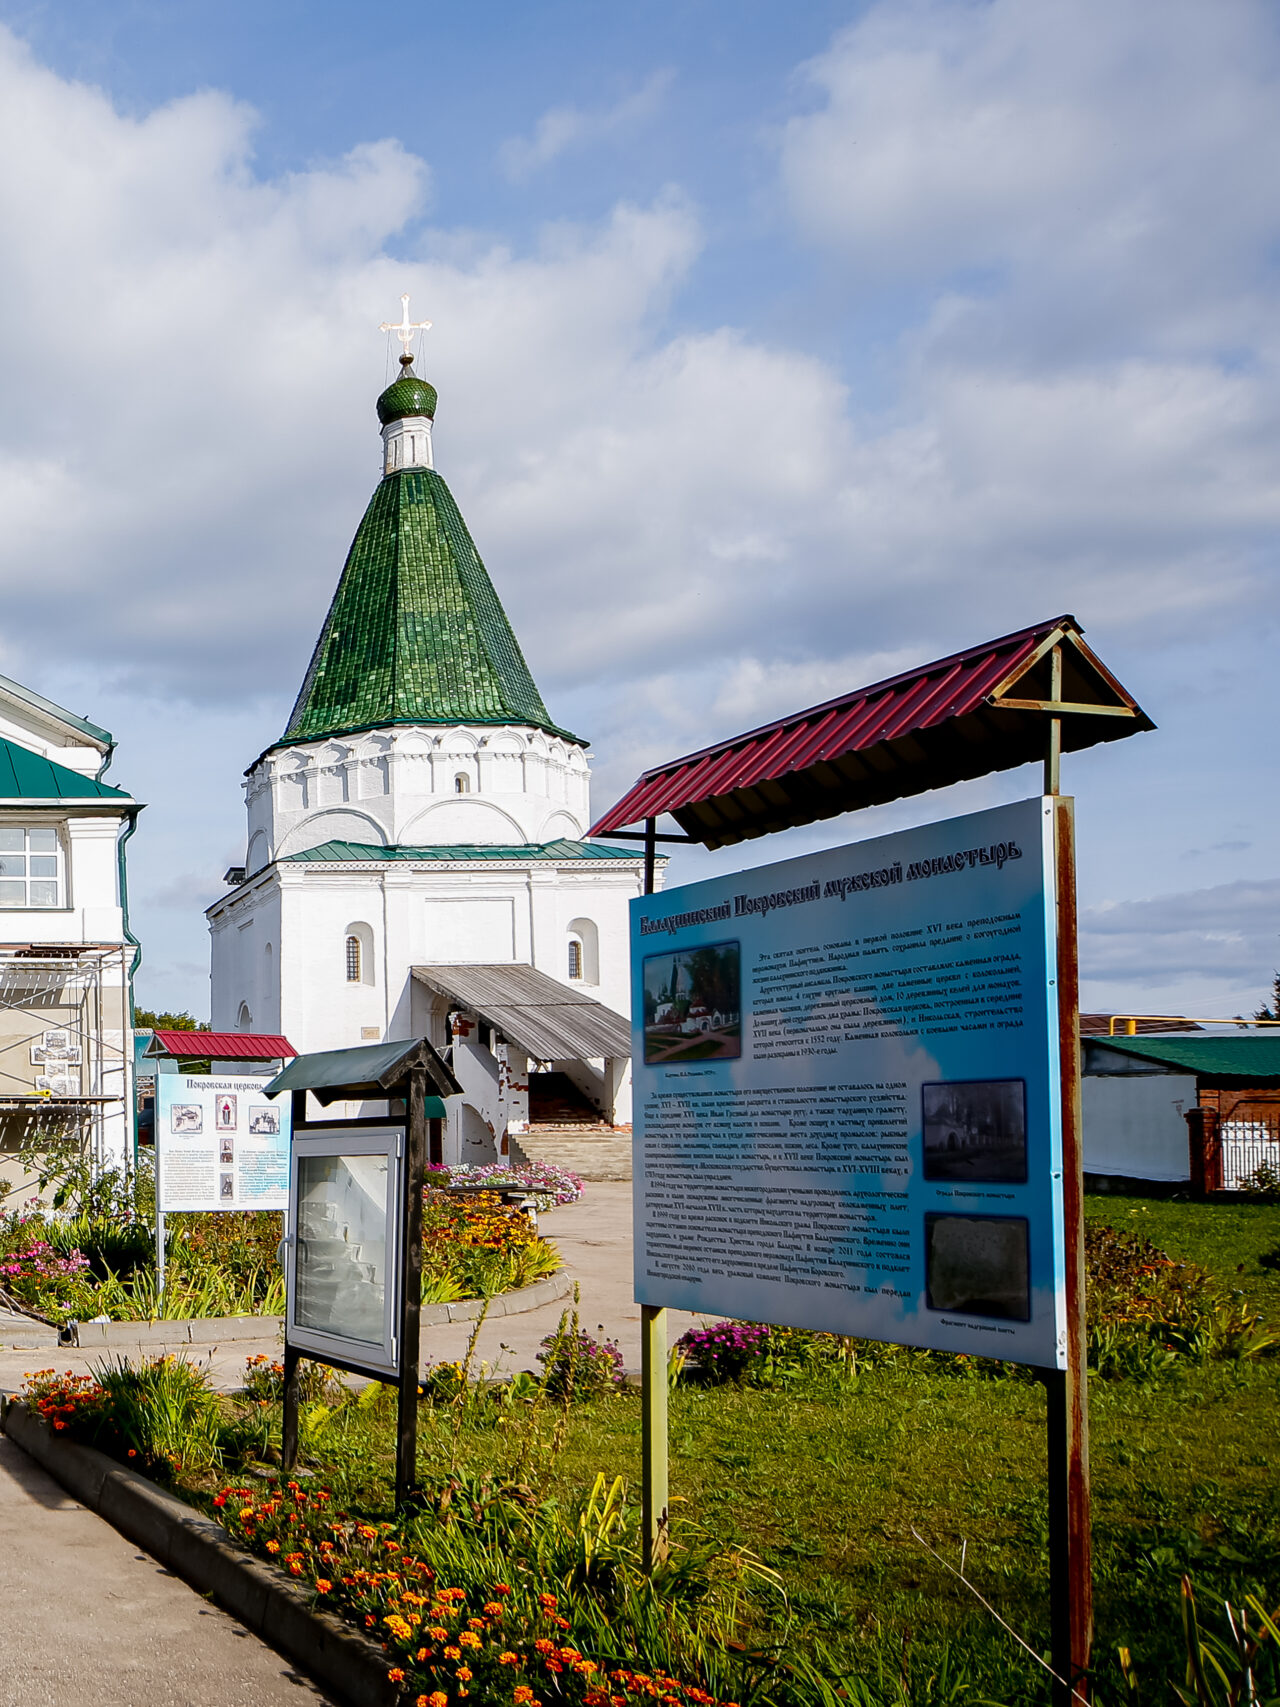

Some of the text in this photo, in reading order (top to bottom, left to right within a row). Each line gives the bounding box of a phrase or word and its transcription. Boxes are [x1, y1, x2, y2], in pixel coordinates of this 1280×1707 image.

[734, 880, 820, 917] Покровский
[823, 861, 902, 901] мужской
[906, 840, 1023, 881] монастырь
[186, 1079, 264, 1092] Покровская церковь
